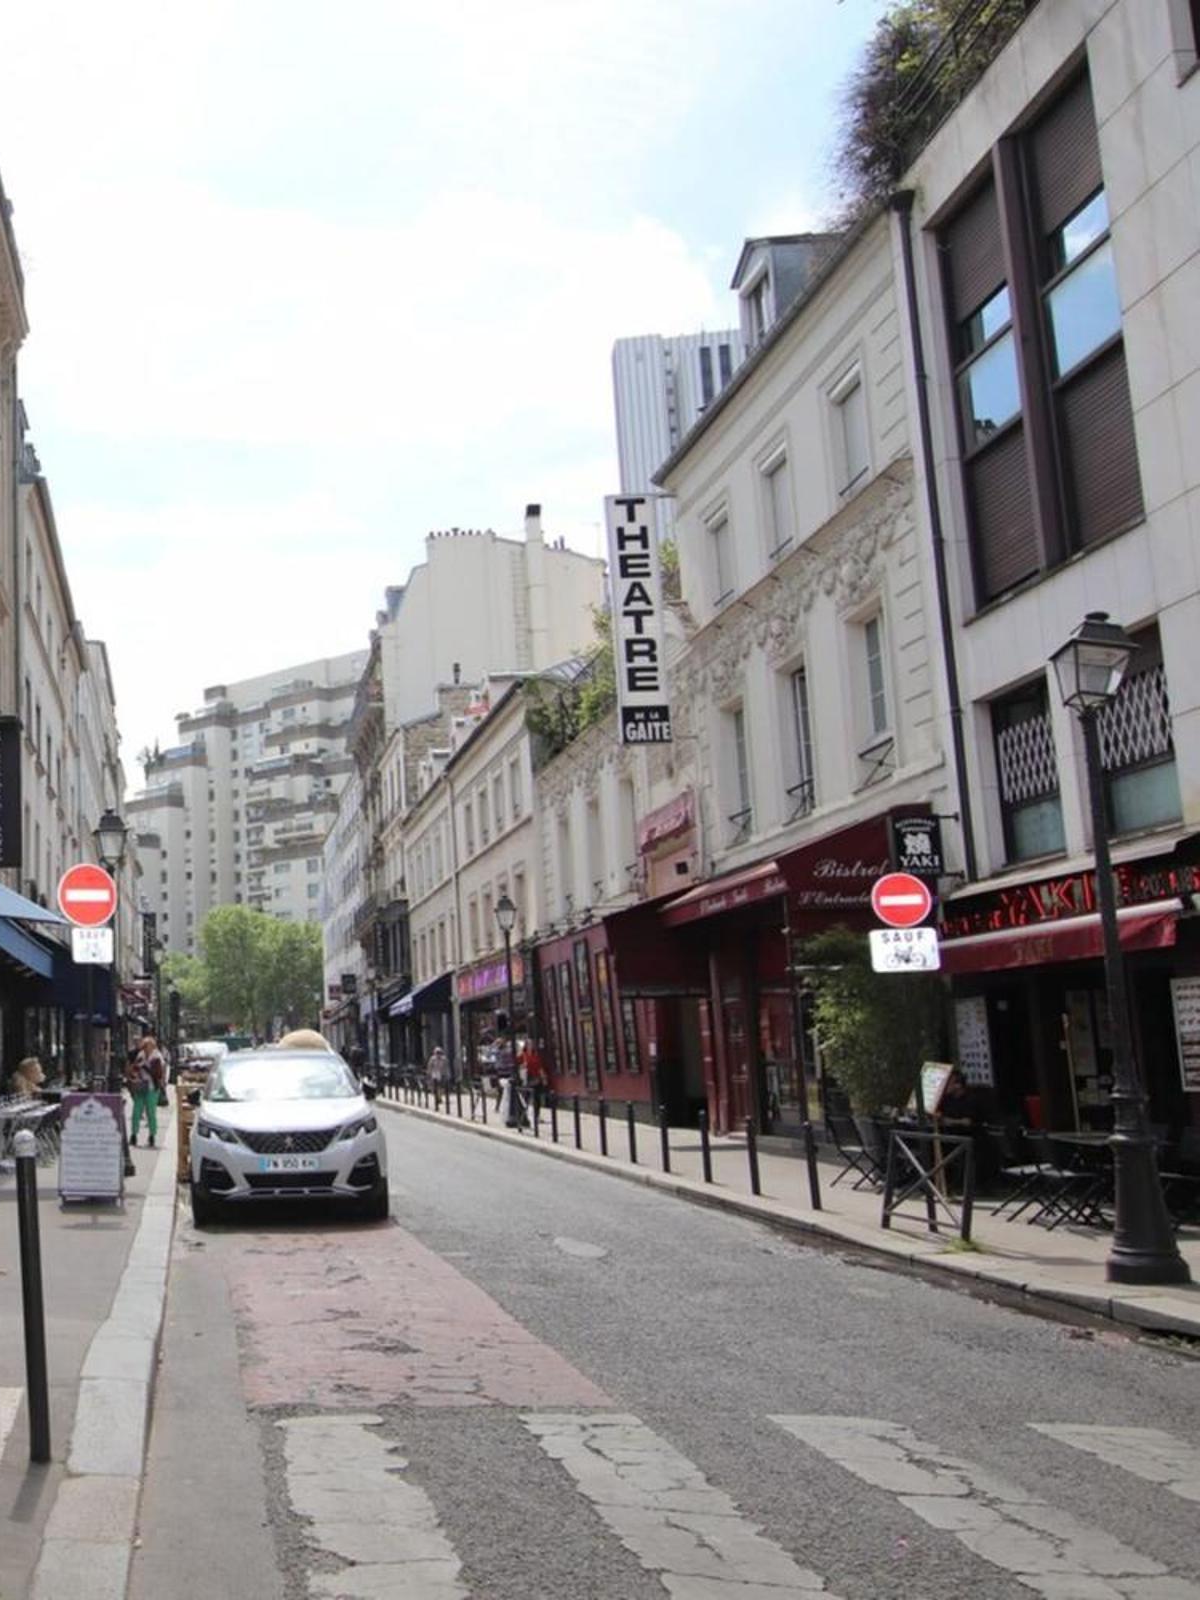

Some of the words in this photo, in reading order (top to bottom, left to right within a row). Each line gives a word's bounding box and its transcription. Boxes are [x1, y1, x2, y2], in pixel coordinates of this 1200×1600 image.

[614, 498, 659, 692] THEATRE
[649, 711, 660, 720] LA
[625, 721, 672, 742] GAITE
[899, 855, 940, 868] YAKI
[881, 930, 923, 944] SAUF
